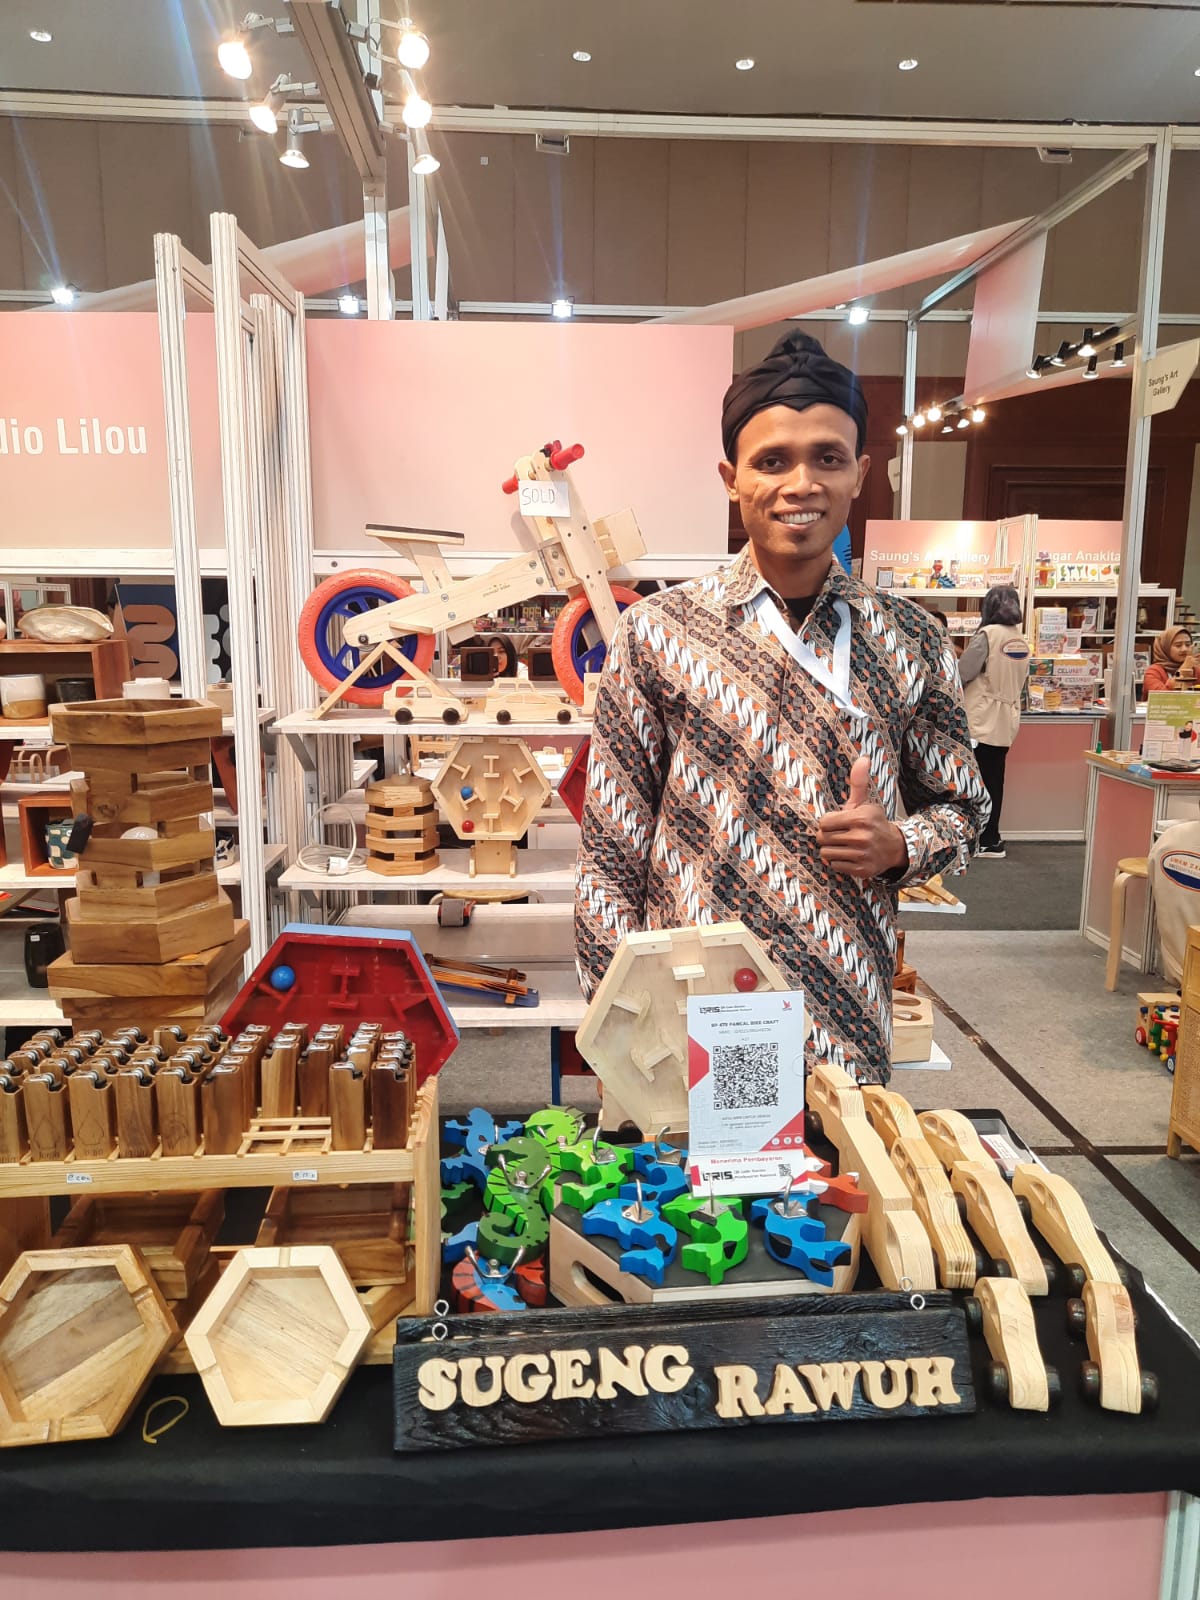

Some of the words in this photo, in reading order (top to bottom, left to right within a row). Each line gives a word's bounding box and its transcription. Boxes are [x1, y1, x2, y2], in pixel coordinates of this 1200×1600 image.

[1148, 374, 1169, 387] Saung's
[1170, 370, 1178, 378] Art
[1153, 386, 1171, 396] Gallery
[56, 418, 147, 455] Lilou
[521, 487, 556, 506] SOLD
[870, 550, 920, 563] Saung's
[418, 1345, 694, 1411] SUGENG
[714, 1356, 961, 1418] RAWUH
